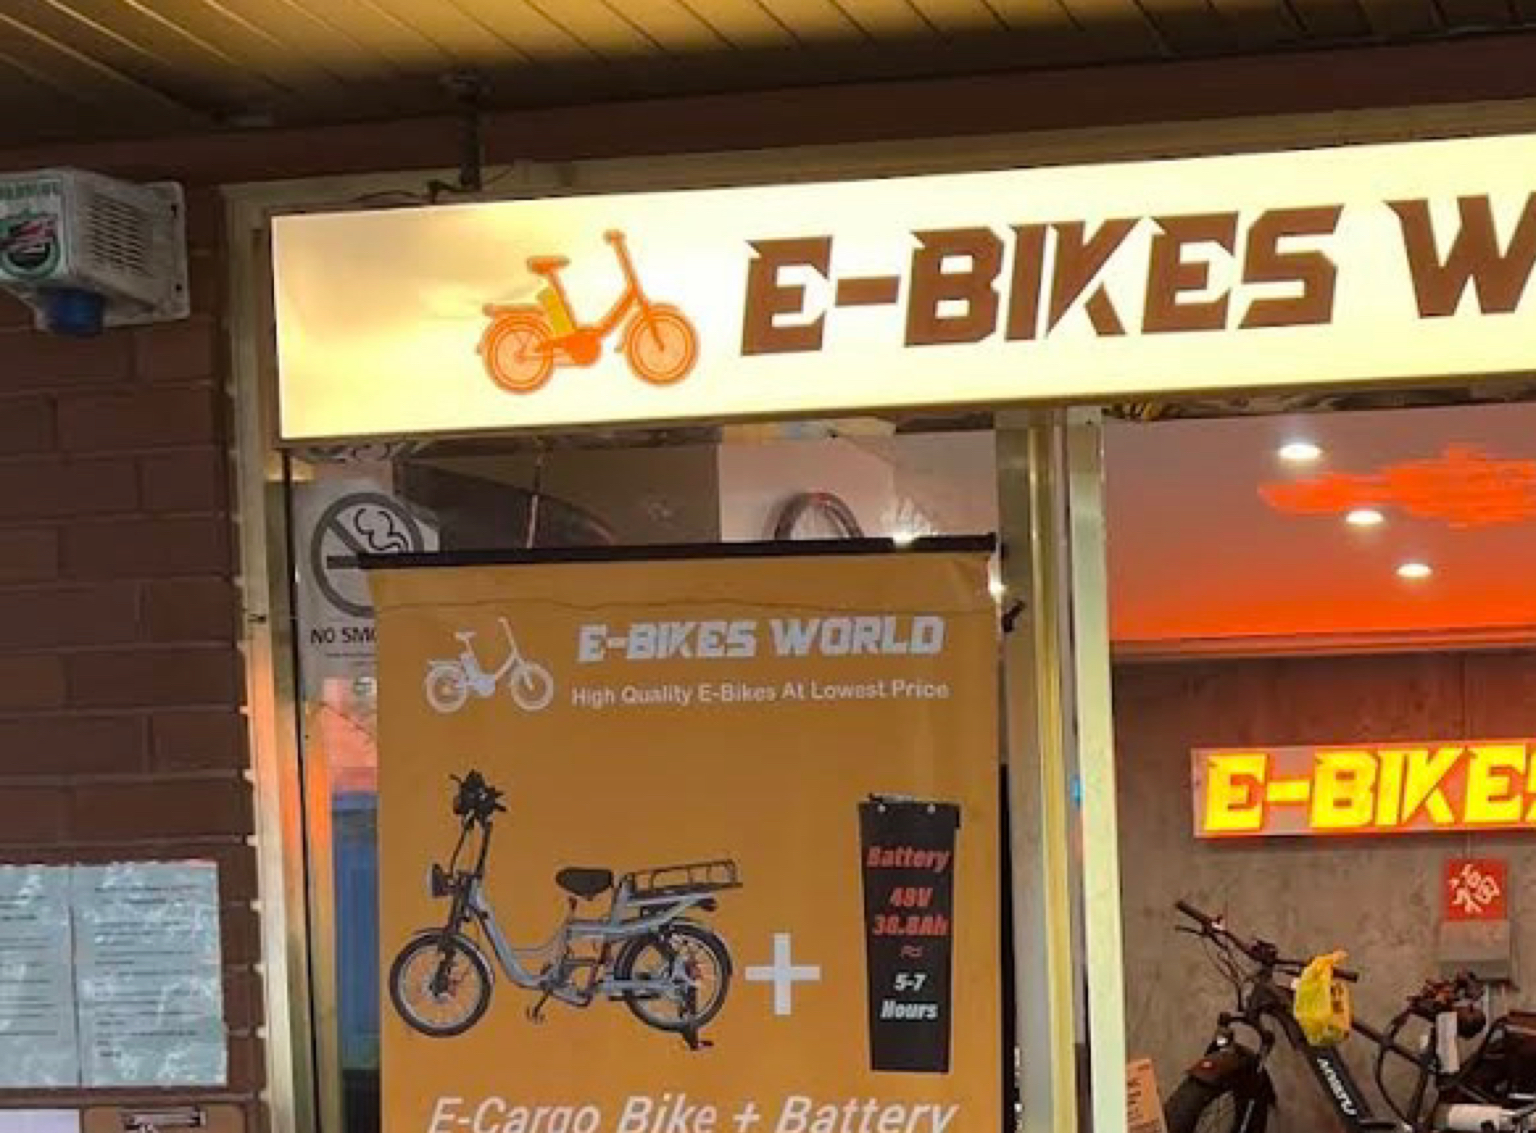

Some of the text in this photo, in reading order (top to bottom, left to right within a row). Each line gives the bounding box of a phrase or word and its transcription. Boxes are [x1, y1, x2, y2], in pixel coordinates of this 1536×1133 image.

[740, 203, 1344, 356] E-BIKES
[310, 629, 335, 643] NO
[576, 616, 944, 662] E-BIKES WORLD
[572, 678, 949, 707] High Quality E-Bikes At Lowest Price
[866, 846, 949, 873] Battery
[894, 973, 926, 991] 5-7
[880, 1000, 939, 1020] Hours
